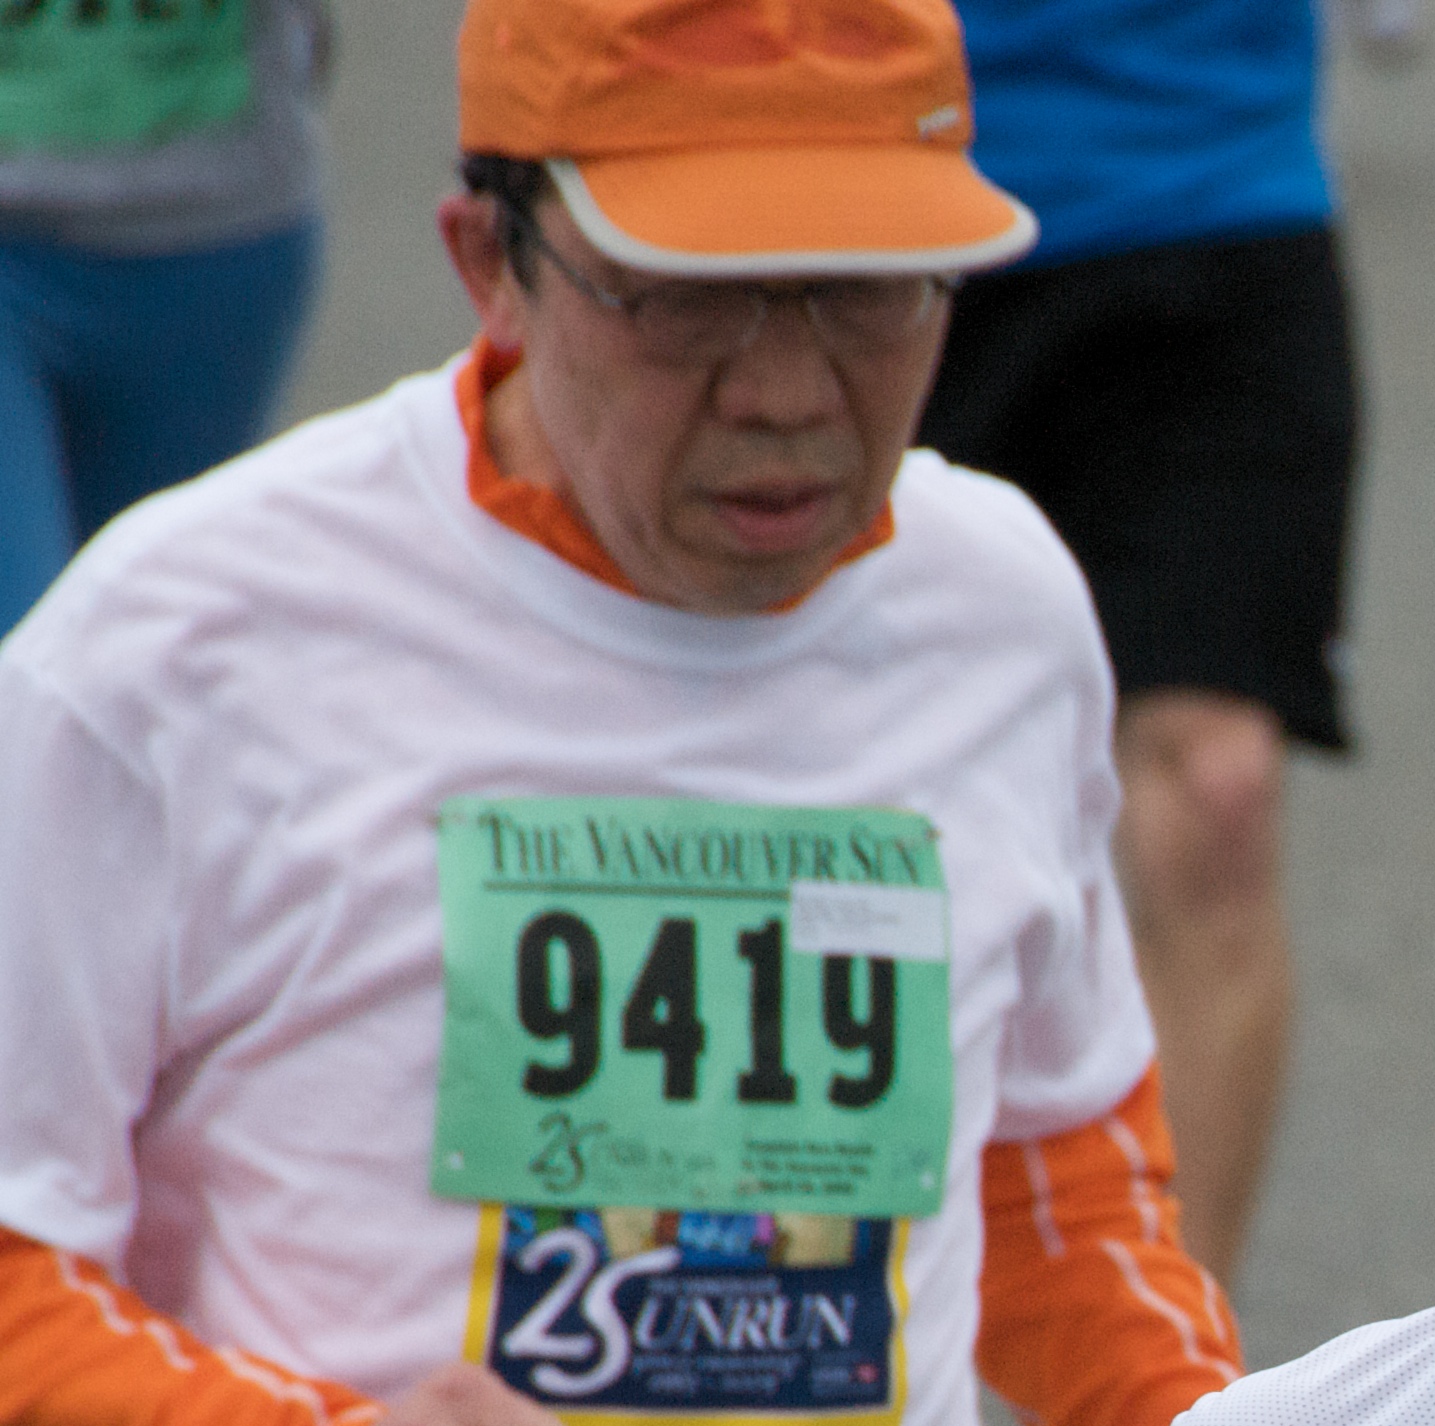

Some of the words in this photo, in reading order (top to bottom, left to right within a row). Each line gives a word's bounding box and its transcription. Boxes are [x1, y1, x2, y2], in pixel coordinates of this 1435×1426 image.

[479, 813, 567, 876] THE
[586, 815, 838, 882] VANCOUVER
[516, 909, 898, 1110] 9419
